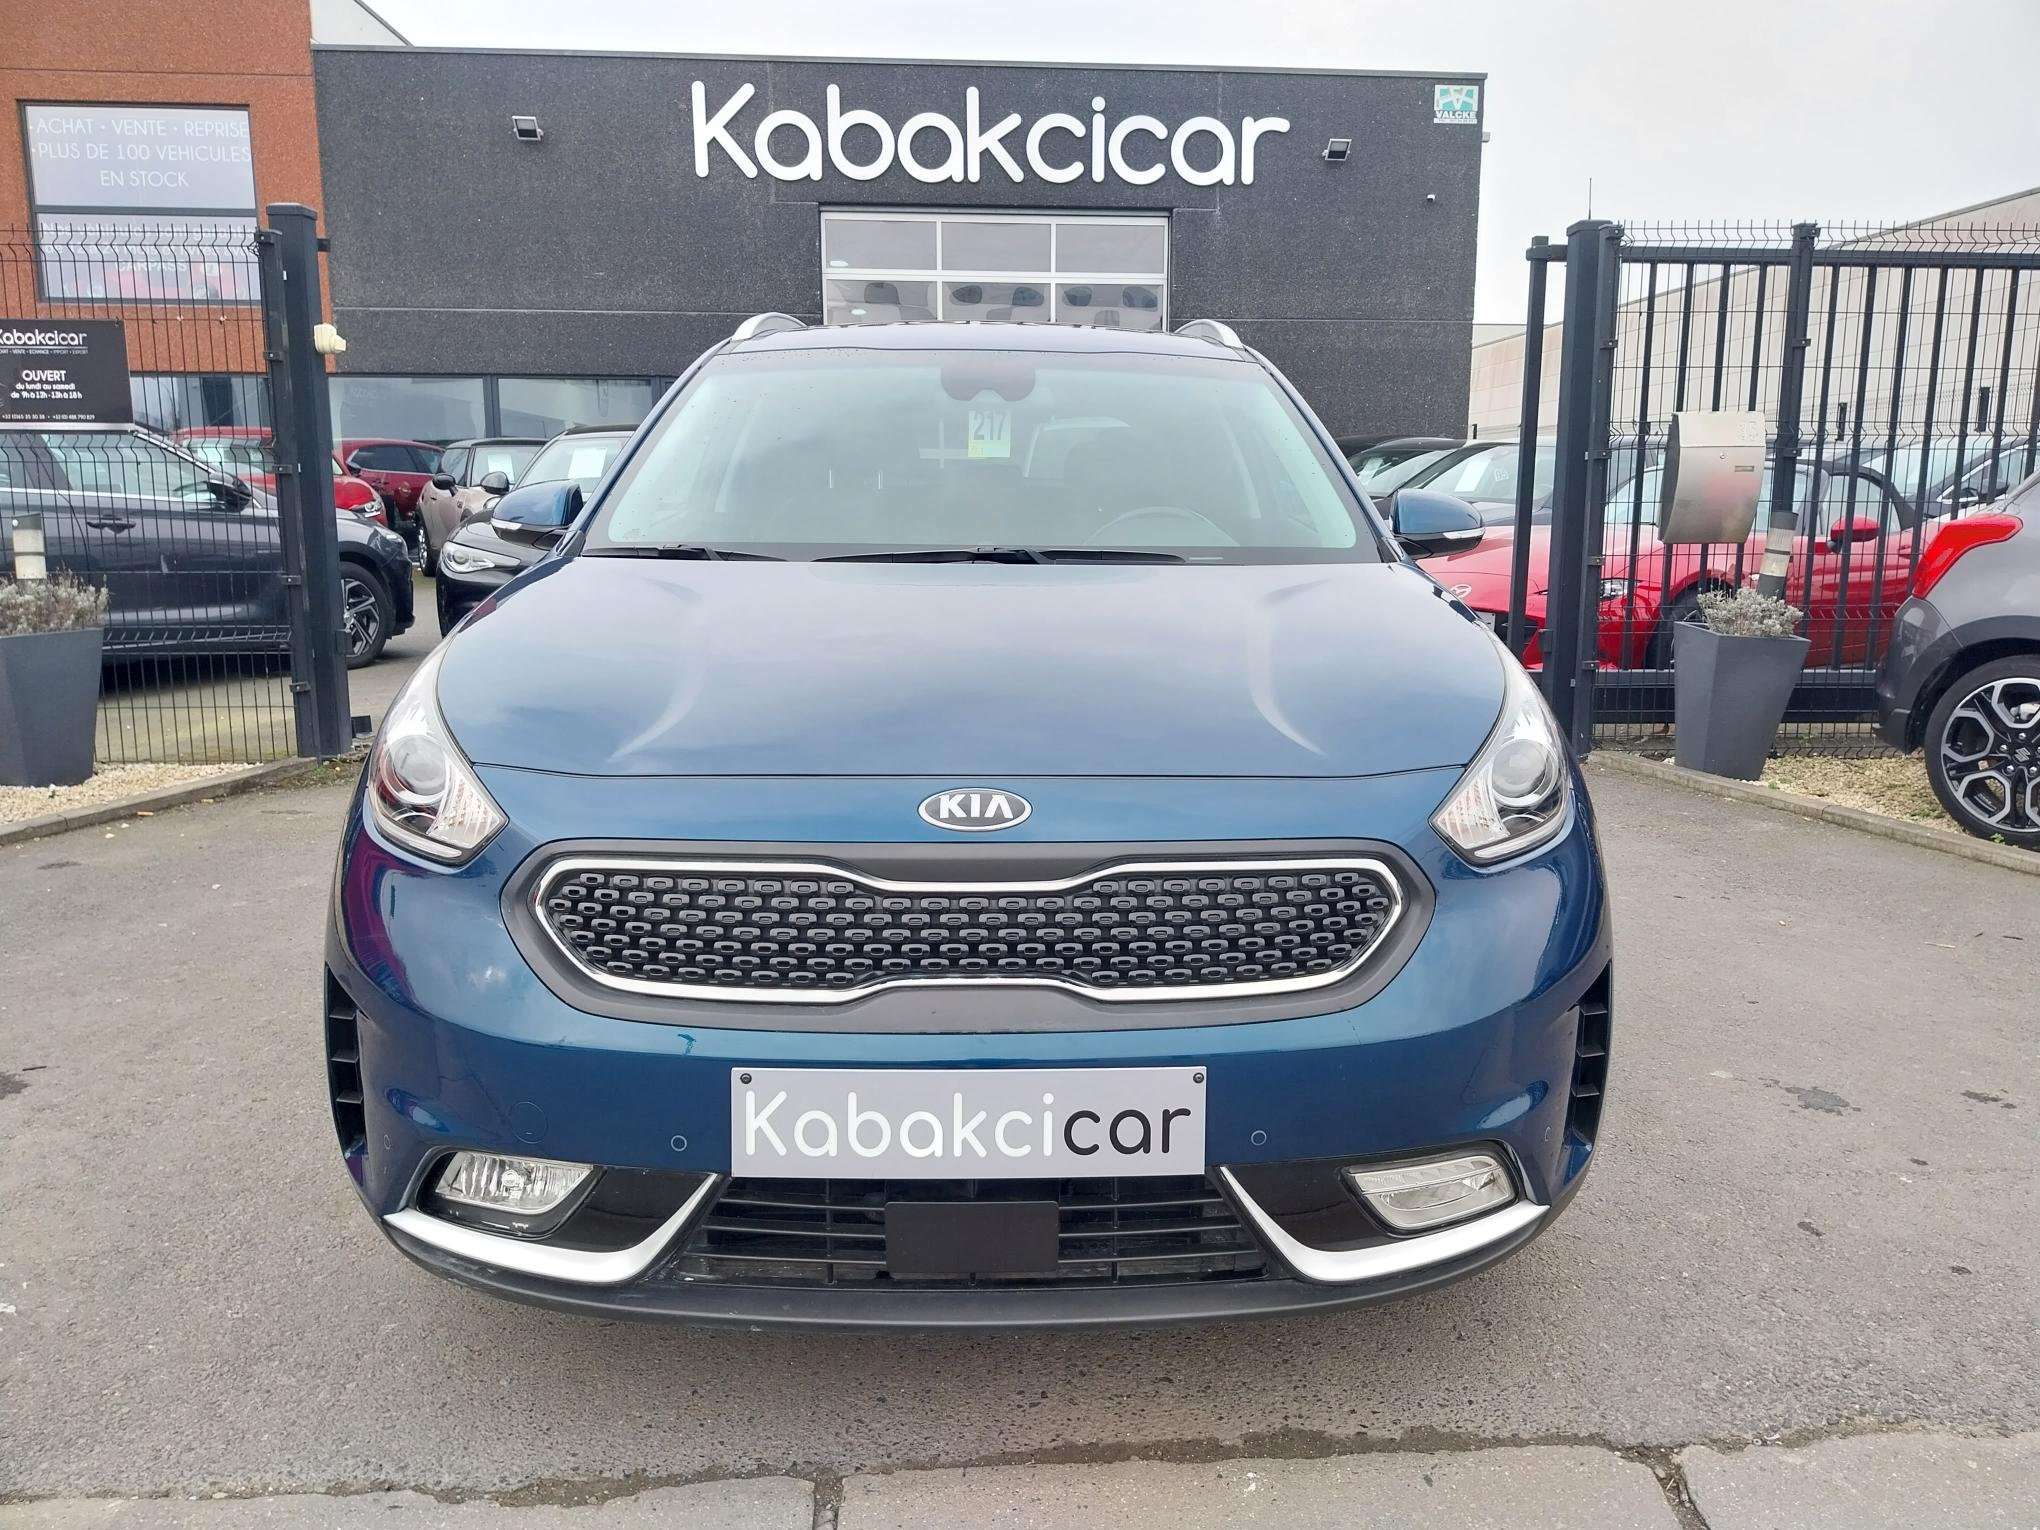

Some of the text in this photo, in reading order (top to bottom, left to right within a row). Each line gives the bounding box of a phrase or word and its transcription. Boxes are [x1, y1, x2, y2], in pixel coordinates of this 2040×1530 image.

[36, 118, 249, 138] ACHAT VENTE REPRISE
[691, 80, 1291, 188] Kabakcicar
[38, 143, 251, 163] PLUS DE 100 VEHICULES
[100, 170, 189, 188] EN STOCK
[22, 369, 66, 381] OUVERT
[10, 391, 20, 399] de
[15, 382, 25, 390] du
[26, 382, 42, 390] lundi
[52, 382, 75, 390] samedi
[973, 411, 1007, 440] 217
[939, 793, 1014, 819] KIA
[745, 1090, 1192, 1158] Kabakcicar
